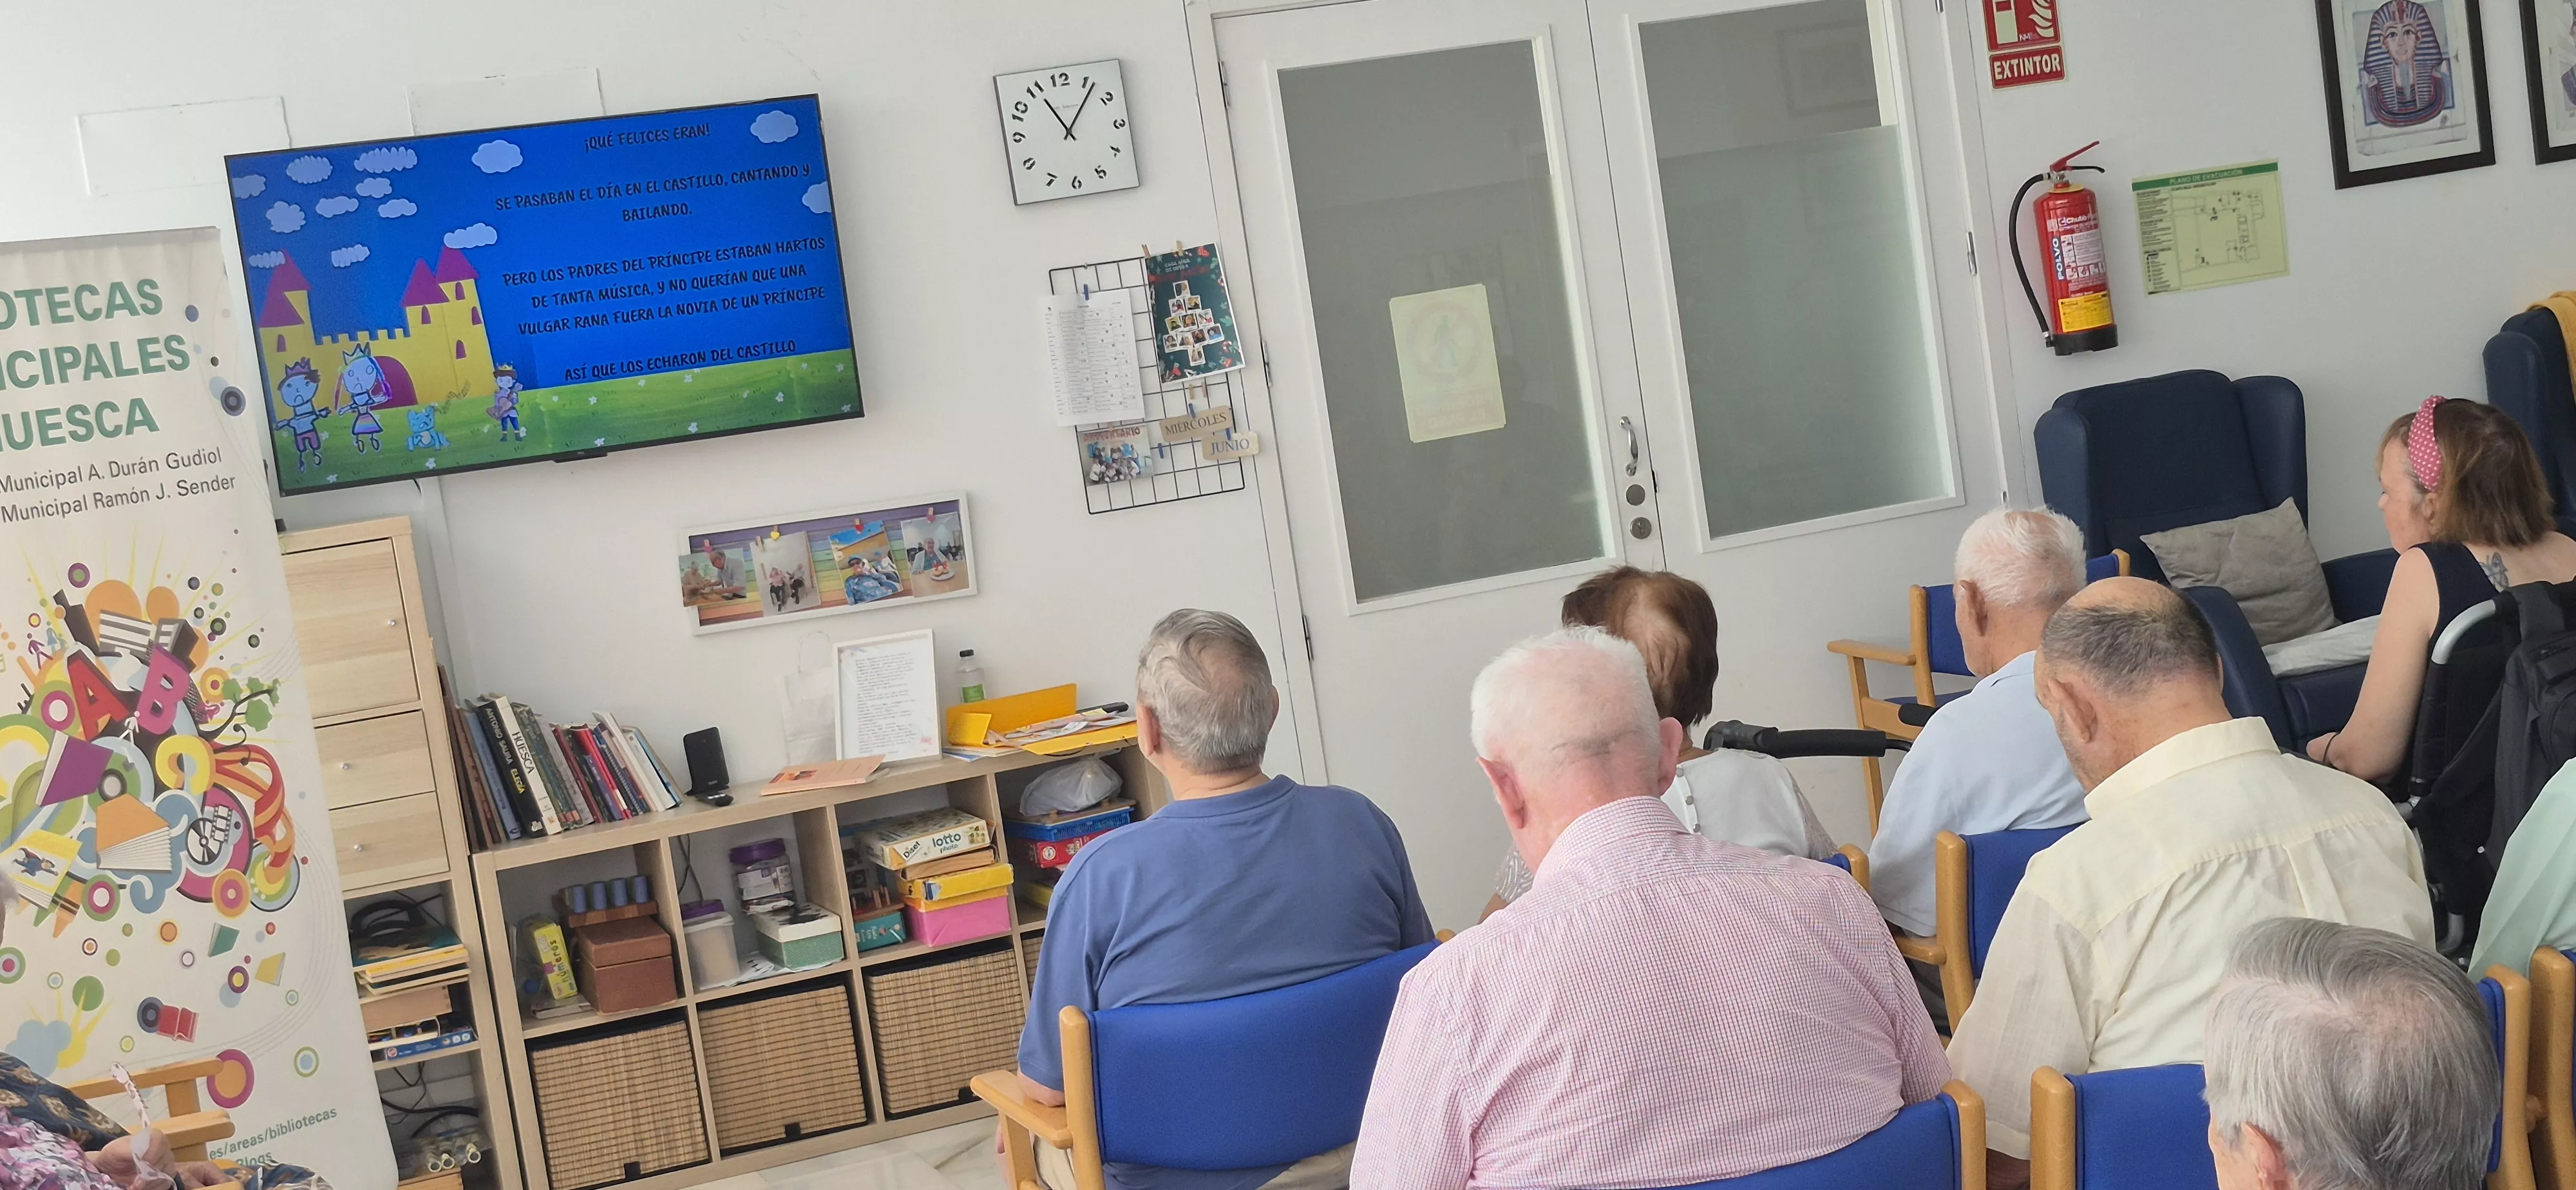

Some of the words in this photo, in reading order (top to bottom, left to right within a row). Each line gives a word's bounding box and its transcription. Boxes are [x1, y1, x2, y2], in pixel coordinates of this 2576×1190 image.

[1994, 53, 2061, 80] EXTINTOR
[1027, 80, 1045, 99] 11
[1050, 72, 1070, 88] 12
[1081, 76, 1090, 89] 1
[1099, 91, 1113, 106] 2
[1012, 100, 1028, 122] 10
[1113, 118, 1126, 129] 3
[585, 131, 613, 153] ¡QUÉ
[618, 128, 670, 145] FELICES
[674, 124, 710, 139] ERAN!
[1012, 131, 1027, 143] 9
[1110, 146, 1121, 158] 4
[1023, 157, 1036, 170] 8
[1094, 165, 1107, 179] 5
[1046, 172, 1058, 187] 7
[1072, 176, 1082, 189] 6
[2202, 169, 2243, 180] EVACUACIÓN
[496, 197, 511, 211] SE
[514, 189, 575, 208] PASABAN
[580, 188, 593, 201] EL
[596, 182, 622, 199] DÍA
[626, 182, 642, 195] EN
[647, 180, 659, 193] EL
[664, 174, 728, 192] CASTILLO,
[731, 165, 798, 184] CANTANDO
[802, 164, 811, 176] Y
[622, 203, 693, 222] BAILANDO.
[502, 271, 537, 287] PERO
[541, 269, 565, 282] LOS
[567, 262, 618, 279] PADRES
[621, 258, 645, 272] DEL
[648, 251, 712, 269] PRÍNCIPE
[716, 243, 772, 261] ESTABAN
[775, 237, 826, 254] HARTOS
[2052, 238, 2065, 280] POLVO
[531, 295, 549, 308] DE
[552, 290, 594, 306] TANTA
[598, 283, 654, 301] MÚSICA,
[658, 281, 665, 294] Y
[670, 278, 687, 291] NO
[692, 269, 748, 290] QUERÍAN
[752, 267, 776, 283] QUE
[781, 264, 807, 276] UNA
[518, 318, 571, 335] VULGAR
[574, 313, 610, 329] RANA
[612, 308, 655, 324] FUERA
[658, 306, 673, 319] LA
[677, 300, 718, 316] NOVIA
[722, 297, 738, 310] DE
[741, 294, 759, 308] UN
[762, 287, 826, 305] PRÍNCIPE
[565, 363, 587, 381] ASÍ
[592, 363, 618, 378] QUE
[621, 360, 643, 374] LOS
[647, 350, 706, 370] ECHARON
[711, 348, 734, 362] DEL
[737, 340, 796, 358] CASTILLO
[0, 397, 160, 451] UESCA
[1164, 412, 1227, 435] MIÉRCOLES
[1209, 439, 1250, 456] JUNIO
[0, 466, 82, 493] Municipal
[88, 463, 105, 481] A.
[109, 457, 159, 478] Durán
[166, 446, 222, 469] Gudiol
[1, 494, 88, 523] Municipal
[93, 487, 150, 509] Ramón
[155, 483, 171, 500] J.
[176, 475, 235, 496] Sender
[486, 708, 504, 739] ANTONIO
[498, 739, 513, 765] SAURA
[510, 768, 526, 795] ELEGÍA
[512, 732, 535, 774] HUESCA
[903, 841, 921, 859] Diset
[932, 833, 961, 848] lotto
[940, 844, 958, 854] photo
[550, 939, 569, 983] números
[209, 1108, 337, 1160] es/areas/bibliotecas
